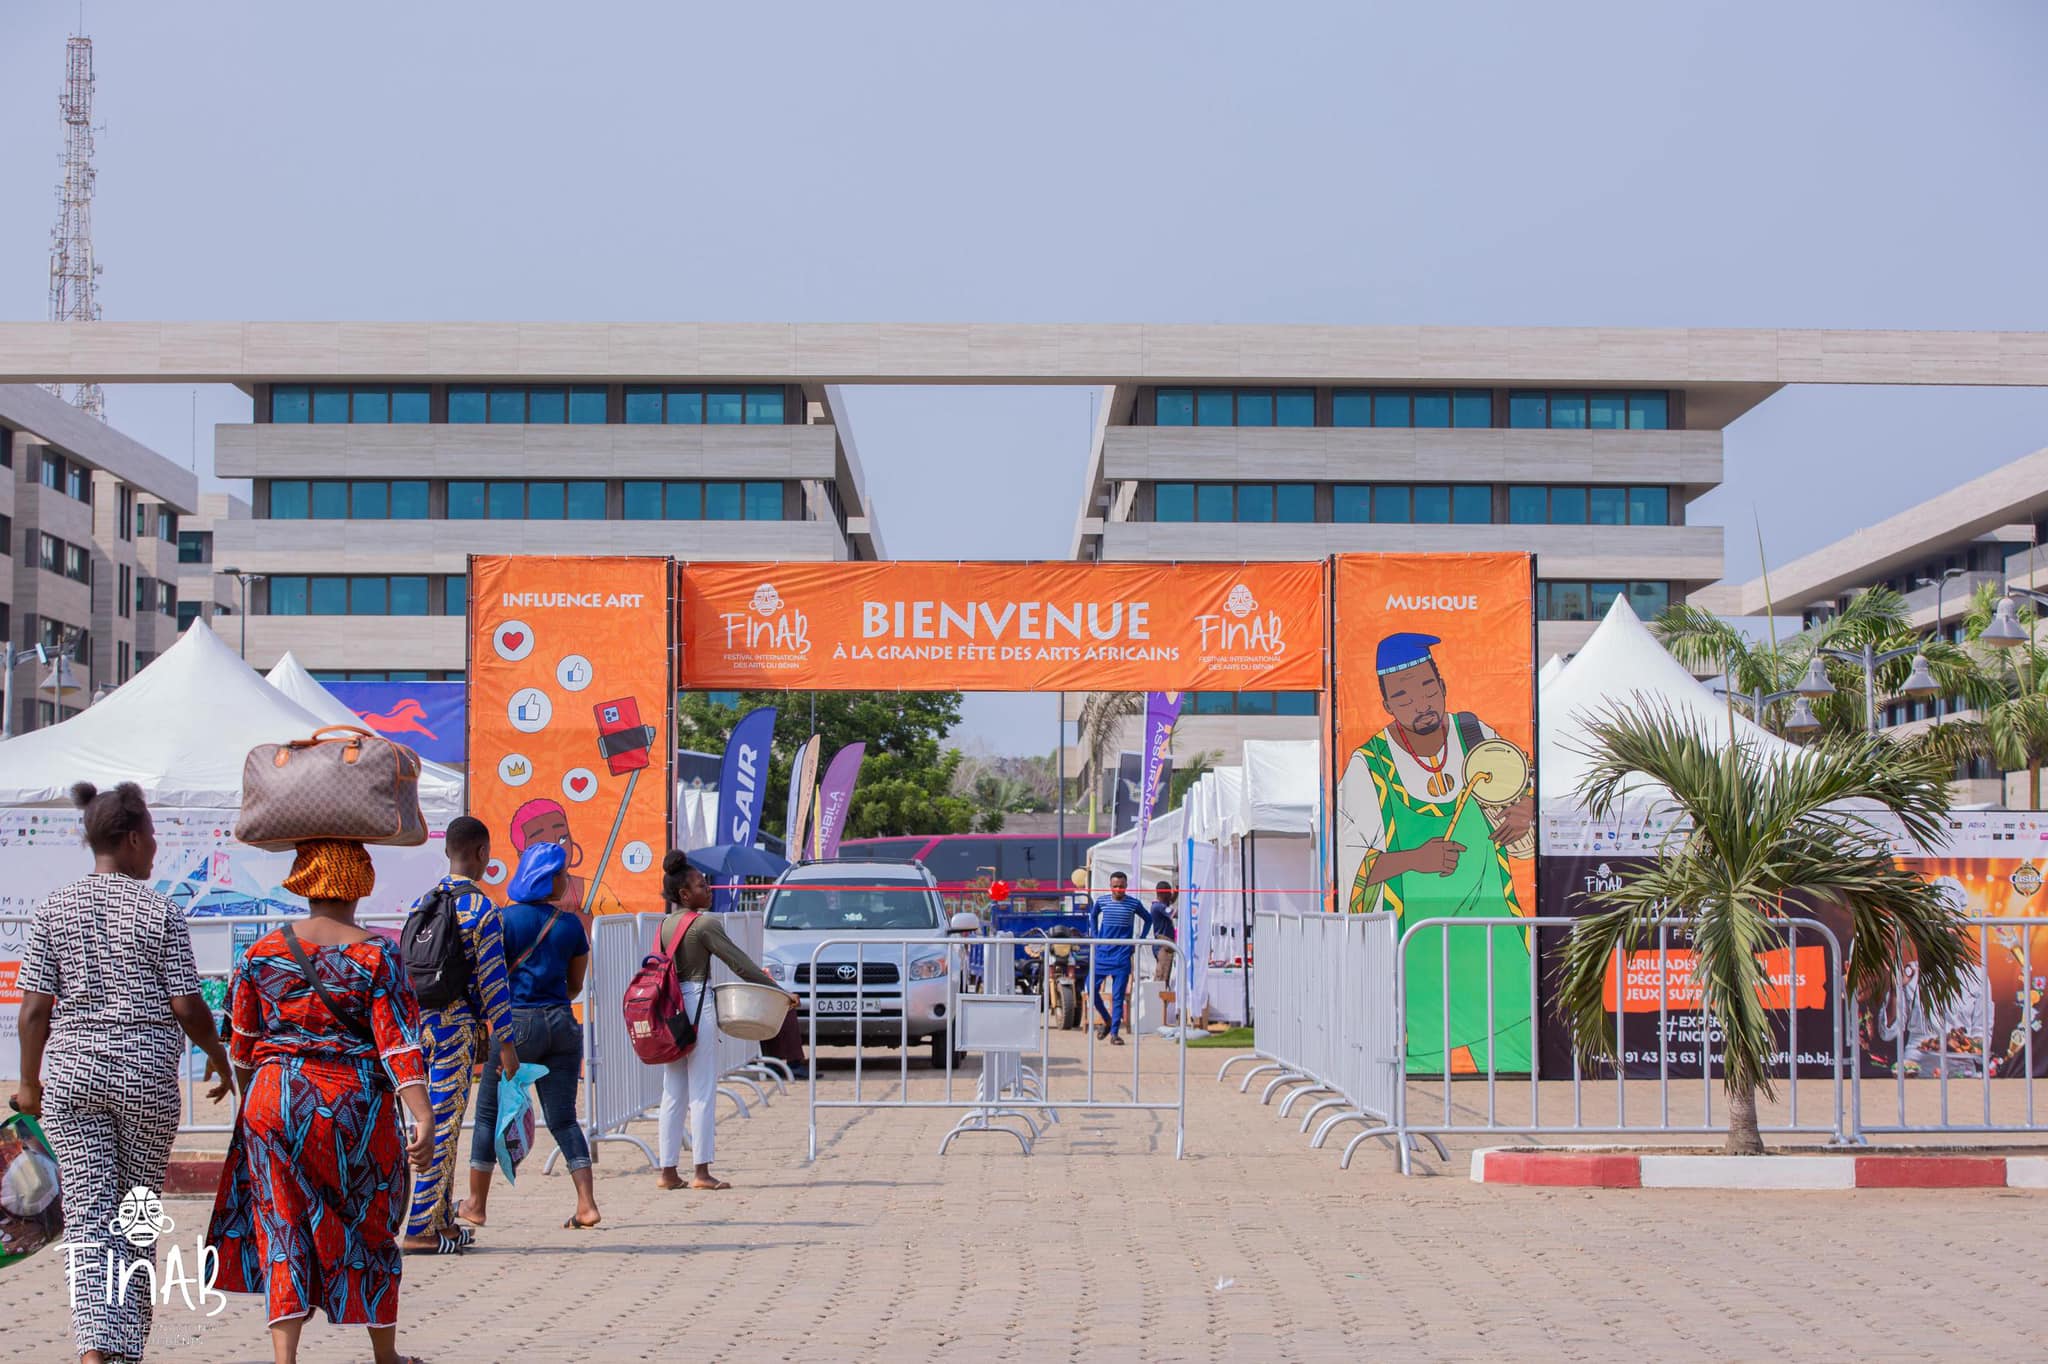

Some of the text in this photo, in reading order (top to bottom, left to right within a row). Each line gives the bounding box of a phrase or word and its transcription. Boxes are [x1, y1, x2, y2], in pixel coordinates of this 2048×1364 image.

[503, 592, 645, 609] INFLUENCE ART
[1384, 594, 1479, 612] MUSIQUE
[862, 600, 1151, 641] BIENVENUE
[754, 653, 809, 661] INTERNATIONAL
[832, 641, 1180, 662] À LA GRANDE FÊTE DES ARTS AFRICAINS
[1229, 655, 1281, 663] INTERNATIONAL
[1627, 958, 1698, 971] GRILLADES
[818, 1000, 834, 1011] CA
[1625, 1051, 1639, 1063] 91
[1641, 1051, 1658, 1064] 43
[1680, 1051, 1697, 1063] 63
